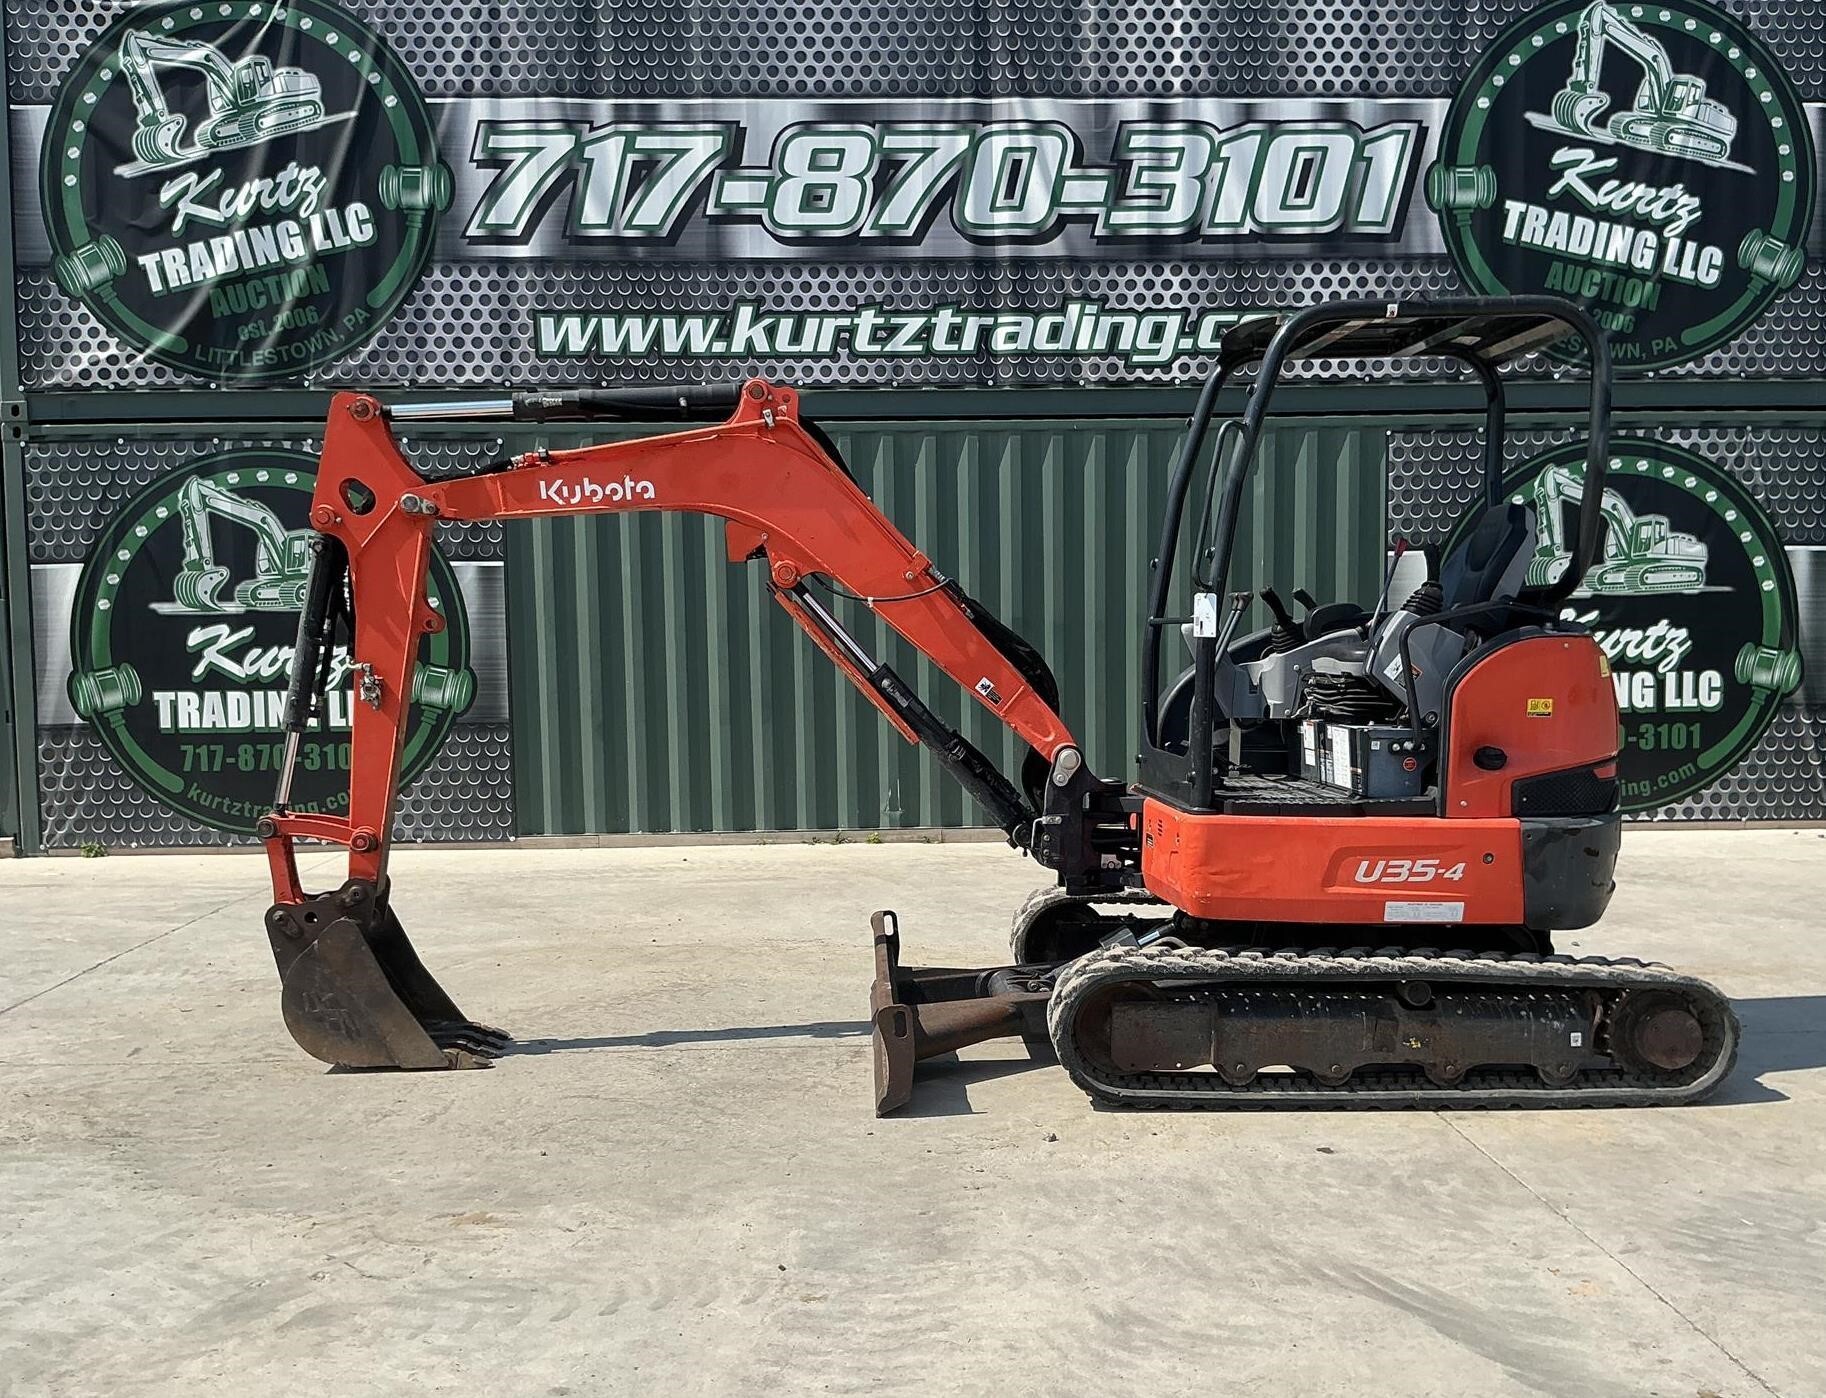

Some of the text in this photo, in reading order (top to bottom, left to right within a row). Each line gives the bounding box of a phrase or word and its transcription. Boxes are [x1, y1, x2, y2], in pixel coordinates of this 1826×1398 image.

[161, 162, 327, 236] Kurtz
[463, 119, 1425, 245] 717-870-3101
[1546, 146, 1702, 238] Kurtz
[138, 202, 376, 296] TRADING LLC
[1503, 200, 1724, 288] TRADING LLC
[209, 263, 330, 318] AUCTION
[1544, 261, 1662, 312] AUCTION
[195, 307, 371, 366] LITTLESTOWN, PA
[536, 301, 1274, 366] www.kurtztrading.c
[1651, 336, 1678, 356] PA
[539, 475, 656, 505] Kubota
[187, 624, 349, 692] Kurz
[153, 690, 321, 733] TRADIN
[1665, 670, 1723, 712] LLC
[181, 743, 351, 772] 717-870-310
[1354, 859, 1466, 883] U35-4
